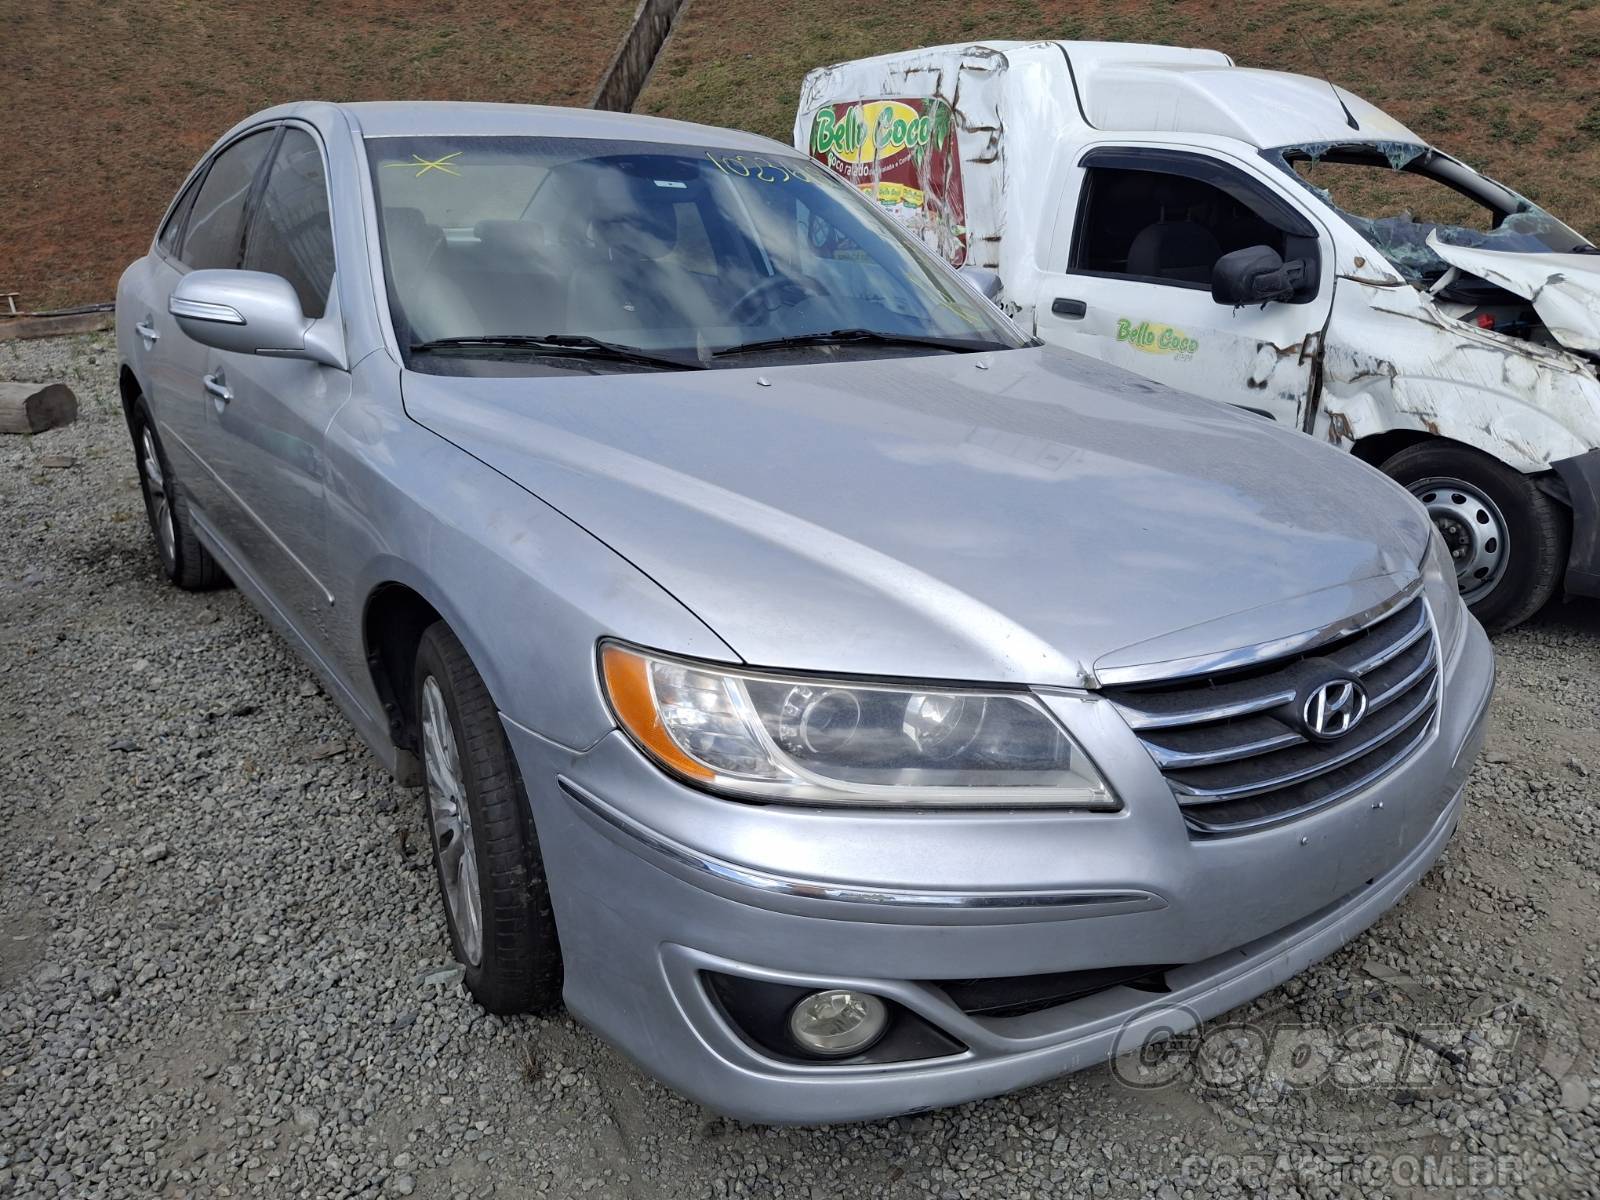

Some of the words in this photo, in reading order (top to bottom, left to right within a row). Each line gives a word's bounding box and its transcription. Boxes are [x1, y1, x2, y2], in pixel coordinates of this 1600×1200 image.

[816, 107, 867, 153] Bello
[873, 106, 931, 150] Coco
[1117, 318, 1154, 346] Bello
[1158, 328, 1198, 353] Coco
